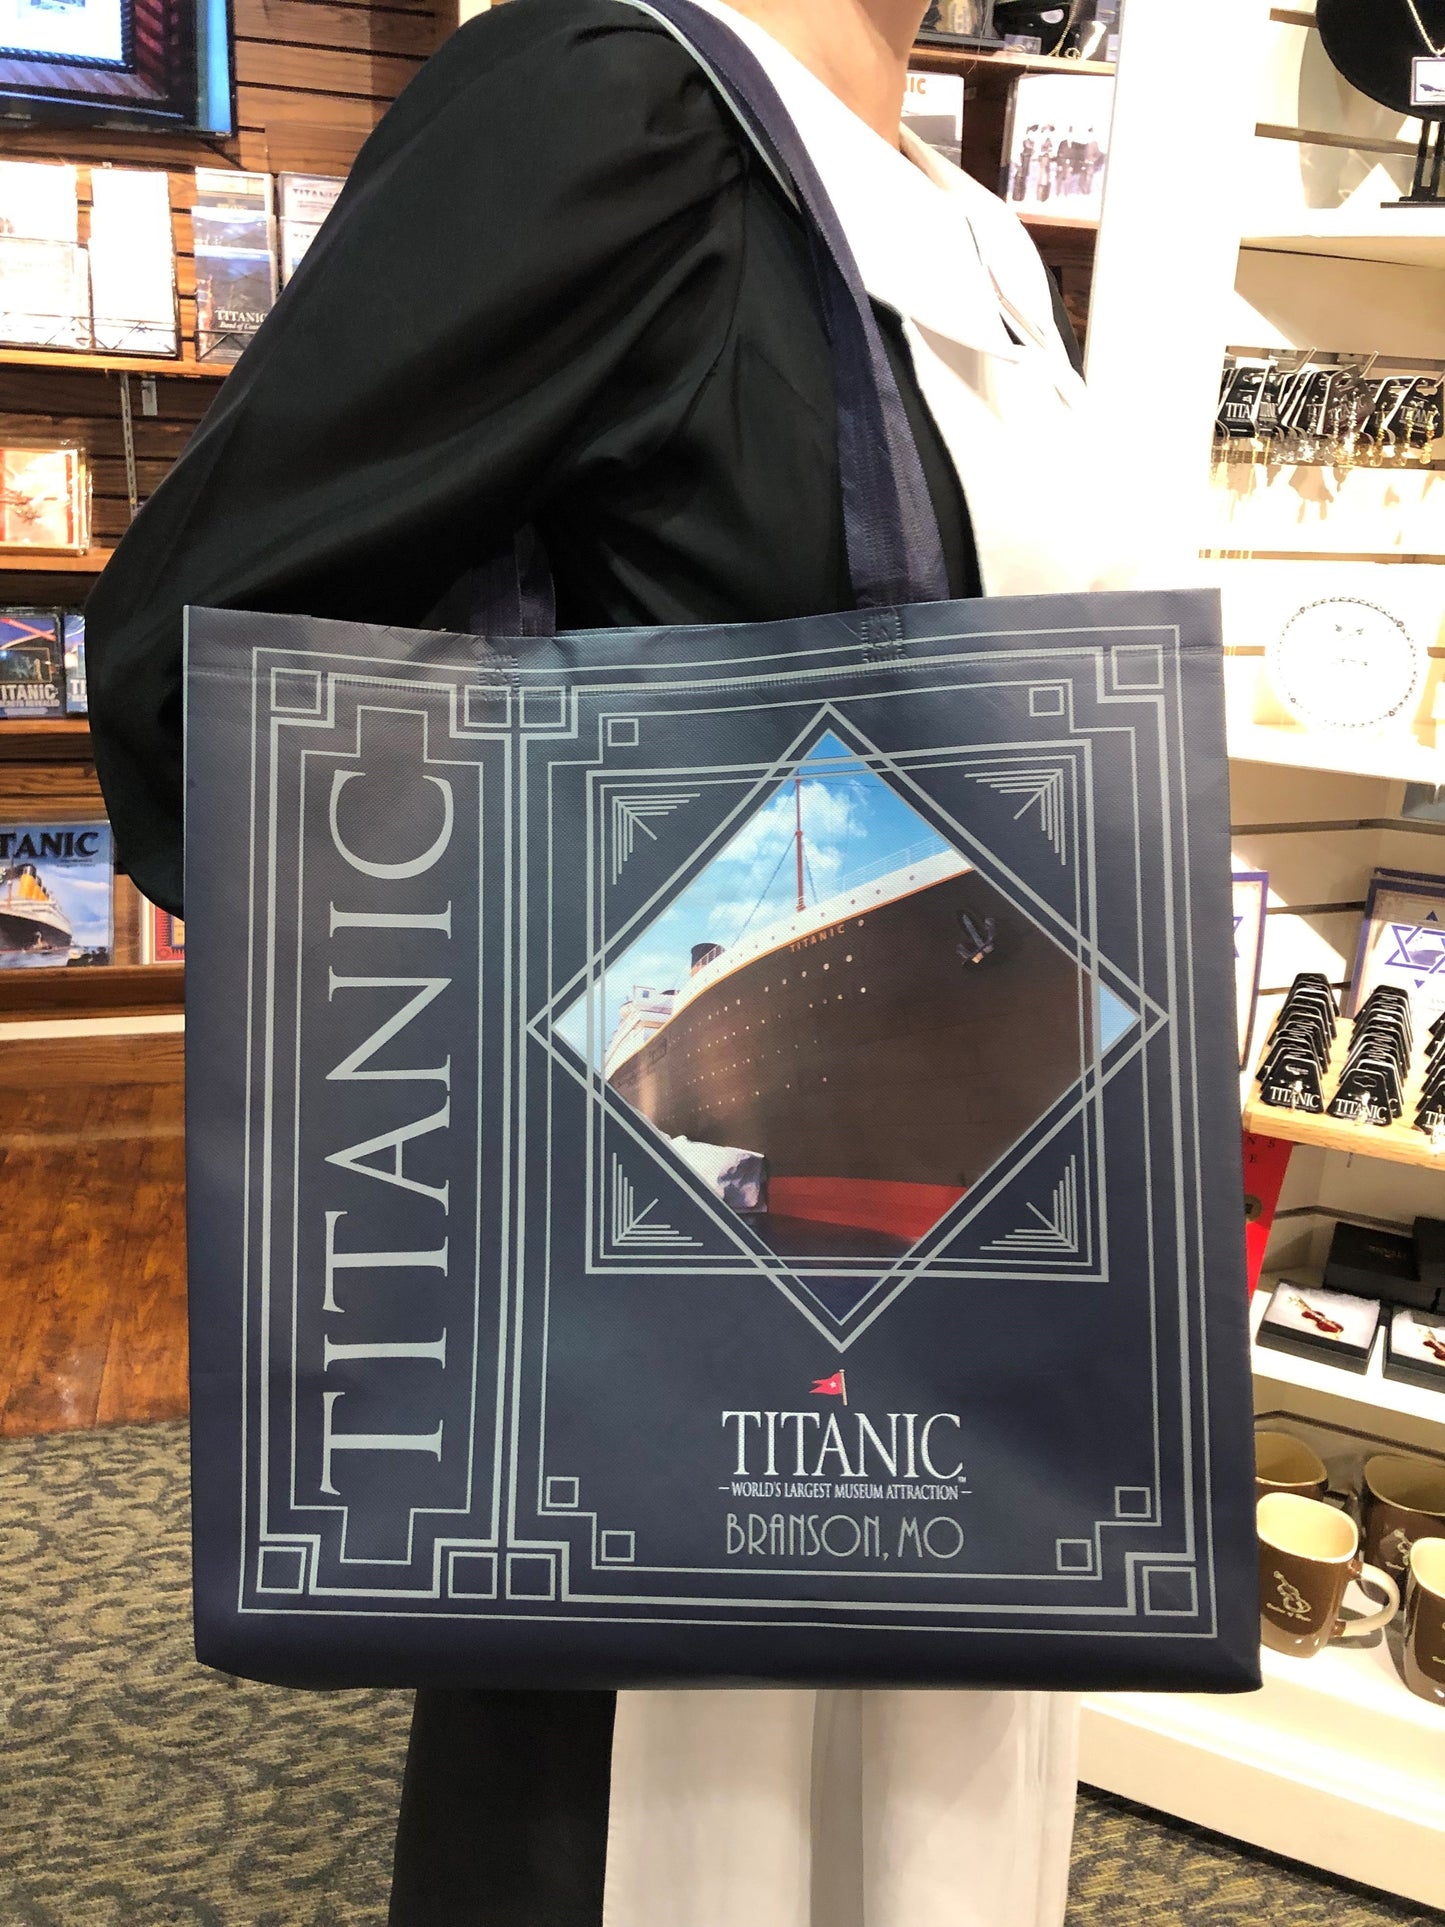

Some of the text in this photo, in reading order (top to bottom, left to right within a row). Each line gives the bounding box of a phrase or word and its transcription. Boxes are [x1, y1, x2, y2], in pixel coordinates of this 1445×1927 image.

[214, 309, 267, 323] TITANIC
[789, 924, 845, 953] TITANIC
[1335, 1098, 1388, 1121] TITANIC
[320, 768, 453, 1496] TITANIC
[722, 1411, 963, 1480] TITANIC
[731, 1481, 959, 1500] WORLD'S LARGEST MUSEUM ATTRACTION
[726, 1512, 965, 1561] BRANSON, MO
